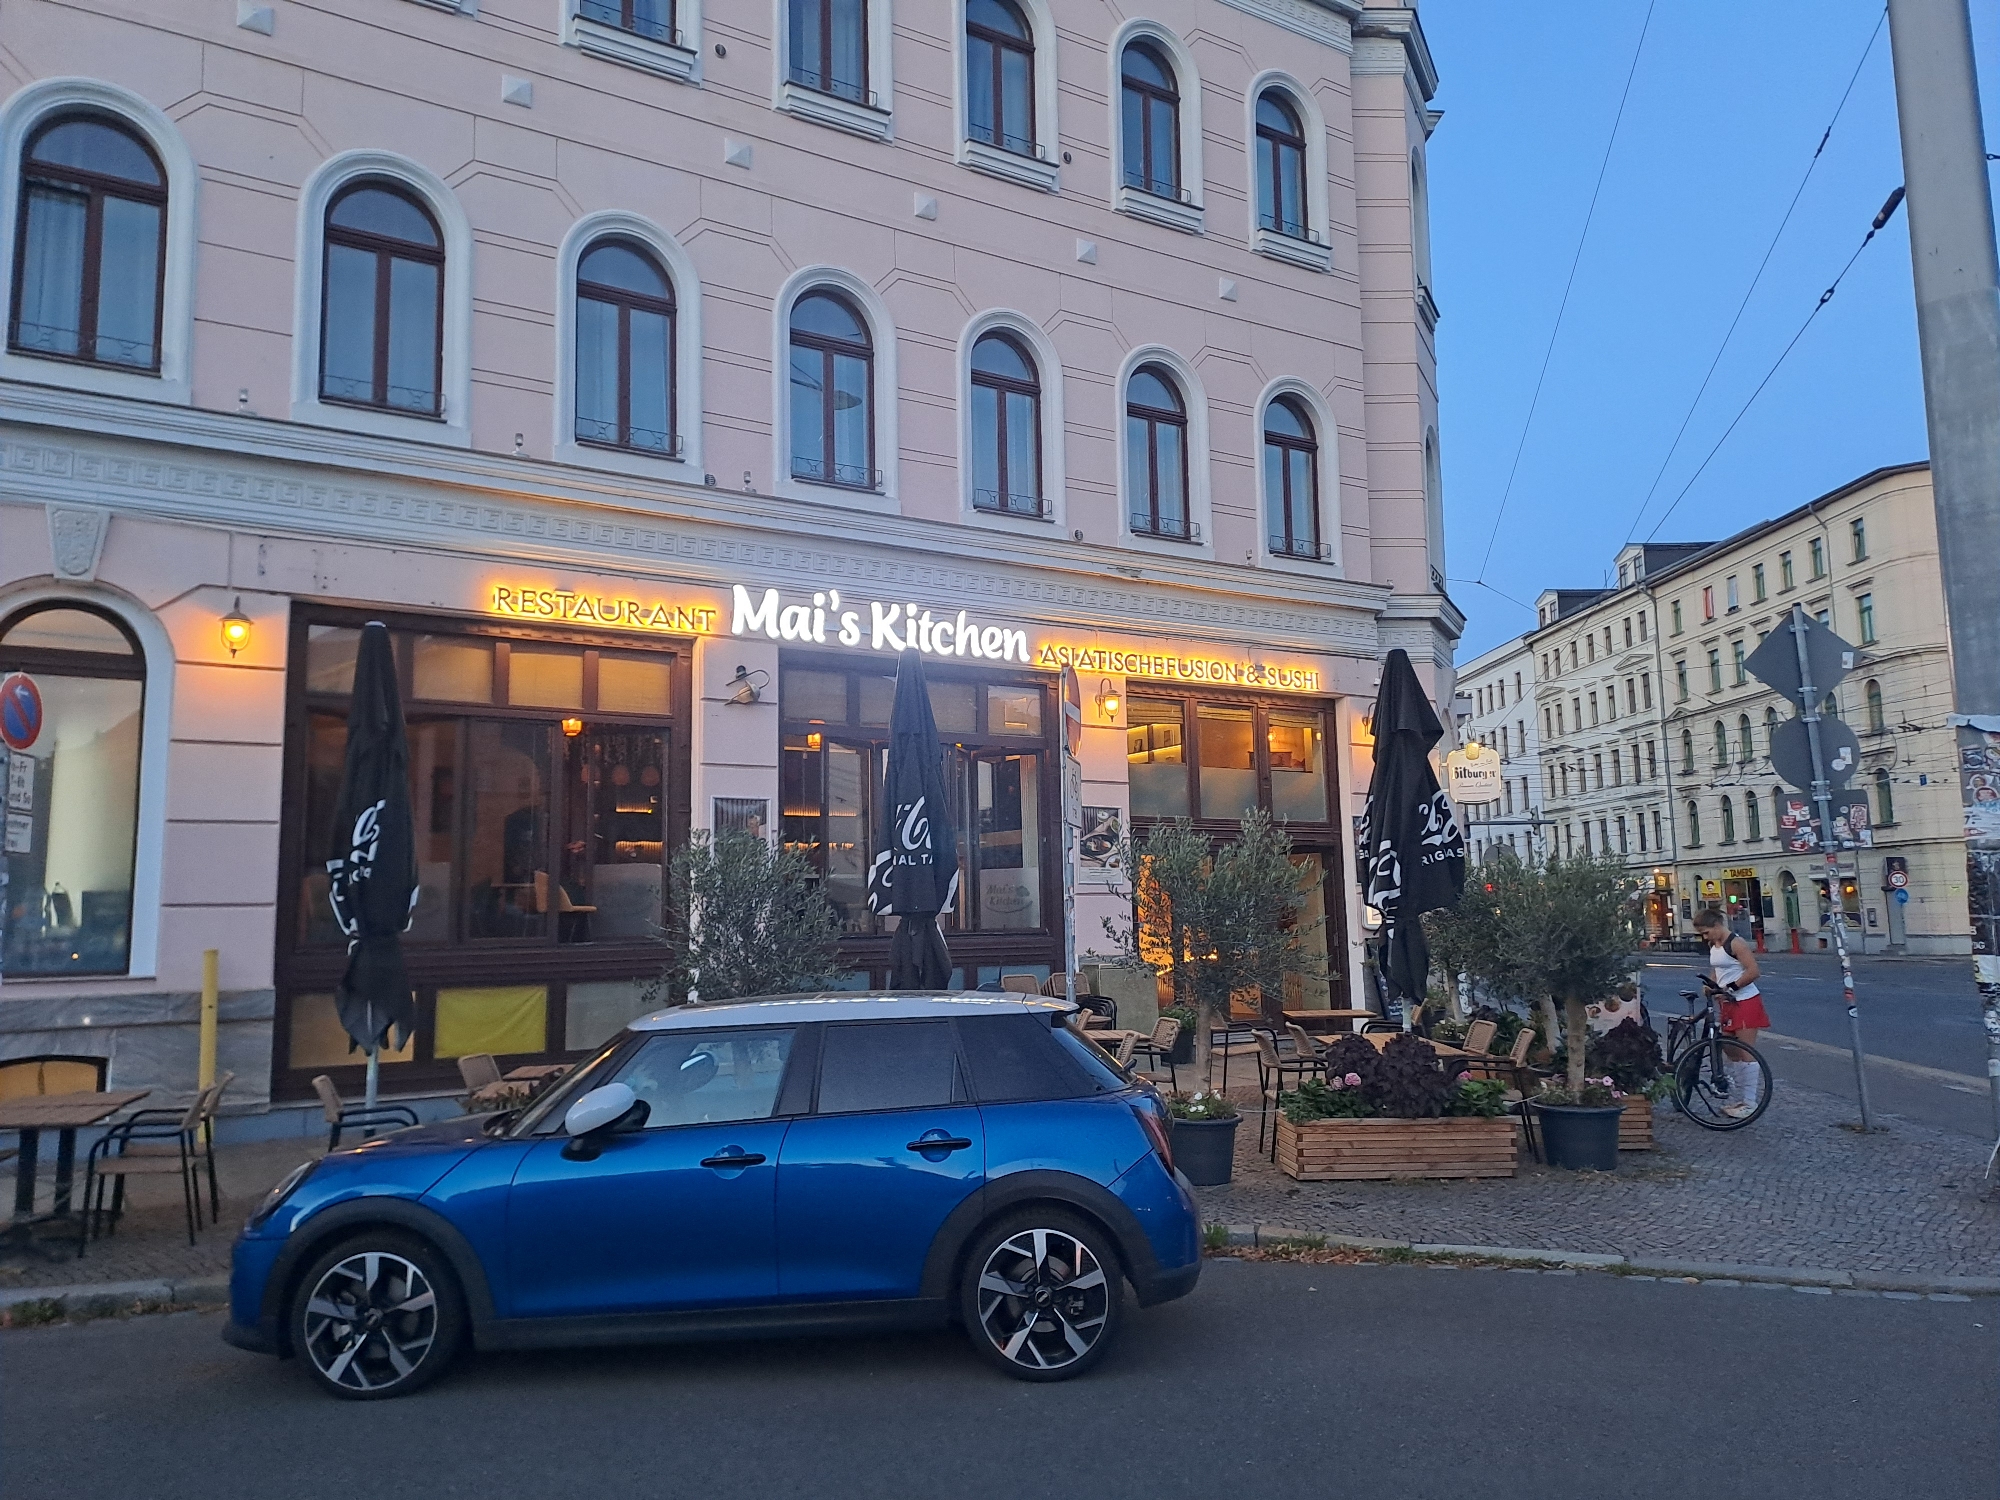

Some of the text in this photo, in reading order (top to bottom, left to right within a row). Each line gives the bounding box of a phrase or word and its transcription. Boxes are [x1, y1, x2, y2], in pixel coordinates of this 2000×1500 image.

[494, 586, 716, 632] RESTAURANT
[731, 584, 1031, 662] Mai's Kitchen
[1246, 665, 1261, 684] &
[1267, 667, 1320, 690] SUSHI
[1893, 875, 1905, 884] 30
